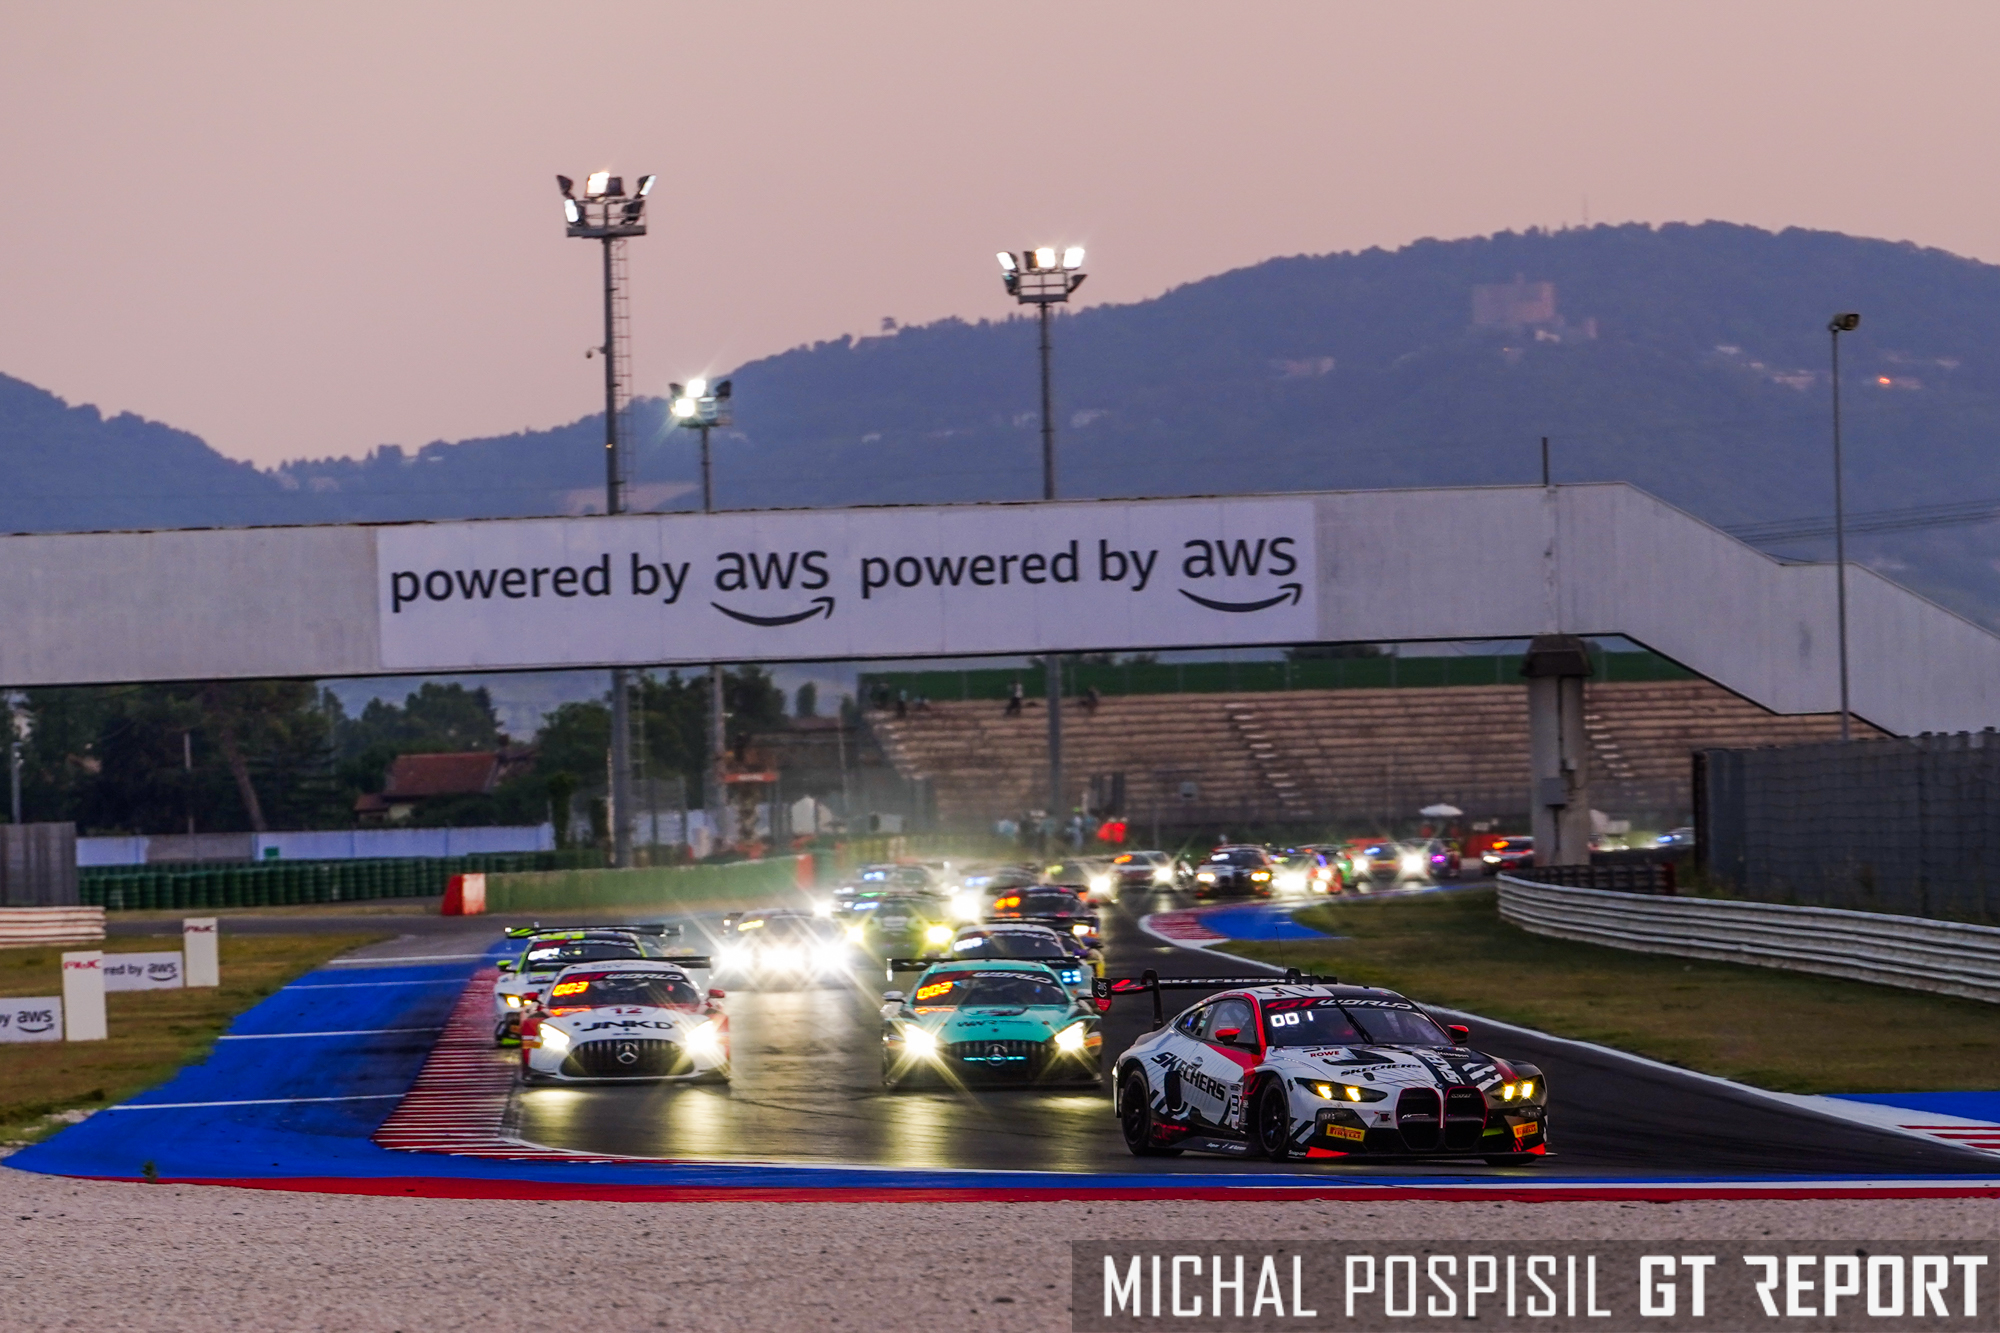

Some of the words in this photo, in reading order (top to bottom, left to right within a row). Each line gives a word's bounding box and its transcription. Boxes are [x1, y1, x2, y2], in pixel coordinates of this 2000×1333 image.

[391, 553, 611, 614] powered
[631, 552, 691, 605] by
[861, 539, 1079, 600] powered
[1099, 538, 1159, 592] by
[127, 964, 144, 977] by
[972, 971, 1053, 984] WORLD
[551, 981, 590, 997] 003
[916, 981, 954, 1000] 002
[1265, 997, 1331, 1010] GT
[1317, 999, 1413, 1009] WORLD
[1310, 1050, 1340, 1058] ROWE
[1150, 1051, 1227, 1102] SKECHERS
[1340, 1063, 1422, 1077] SKECHERS
[1329, 1126, 1362, 1140] PIRELLI
